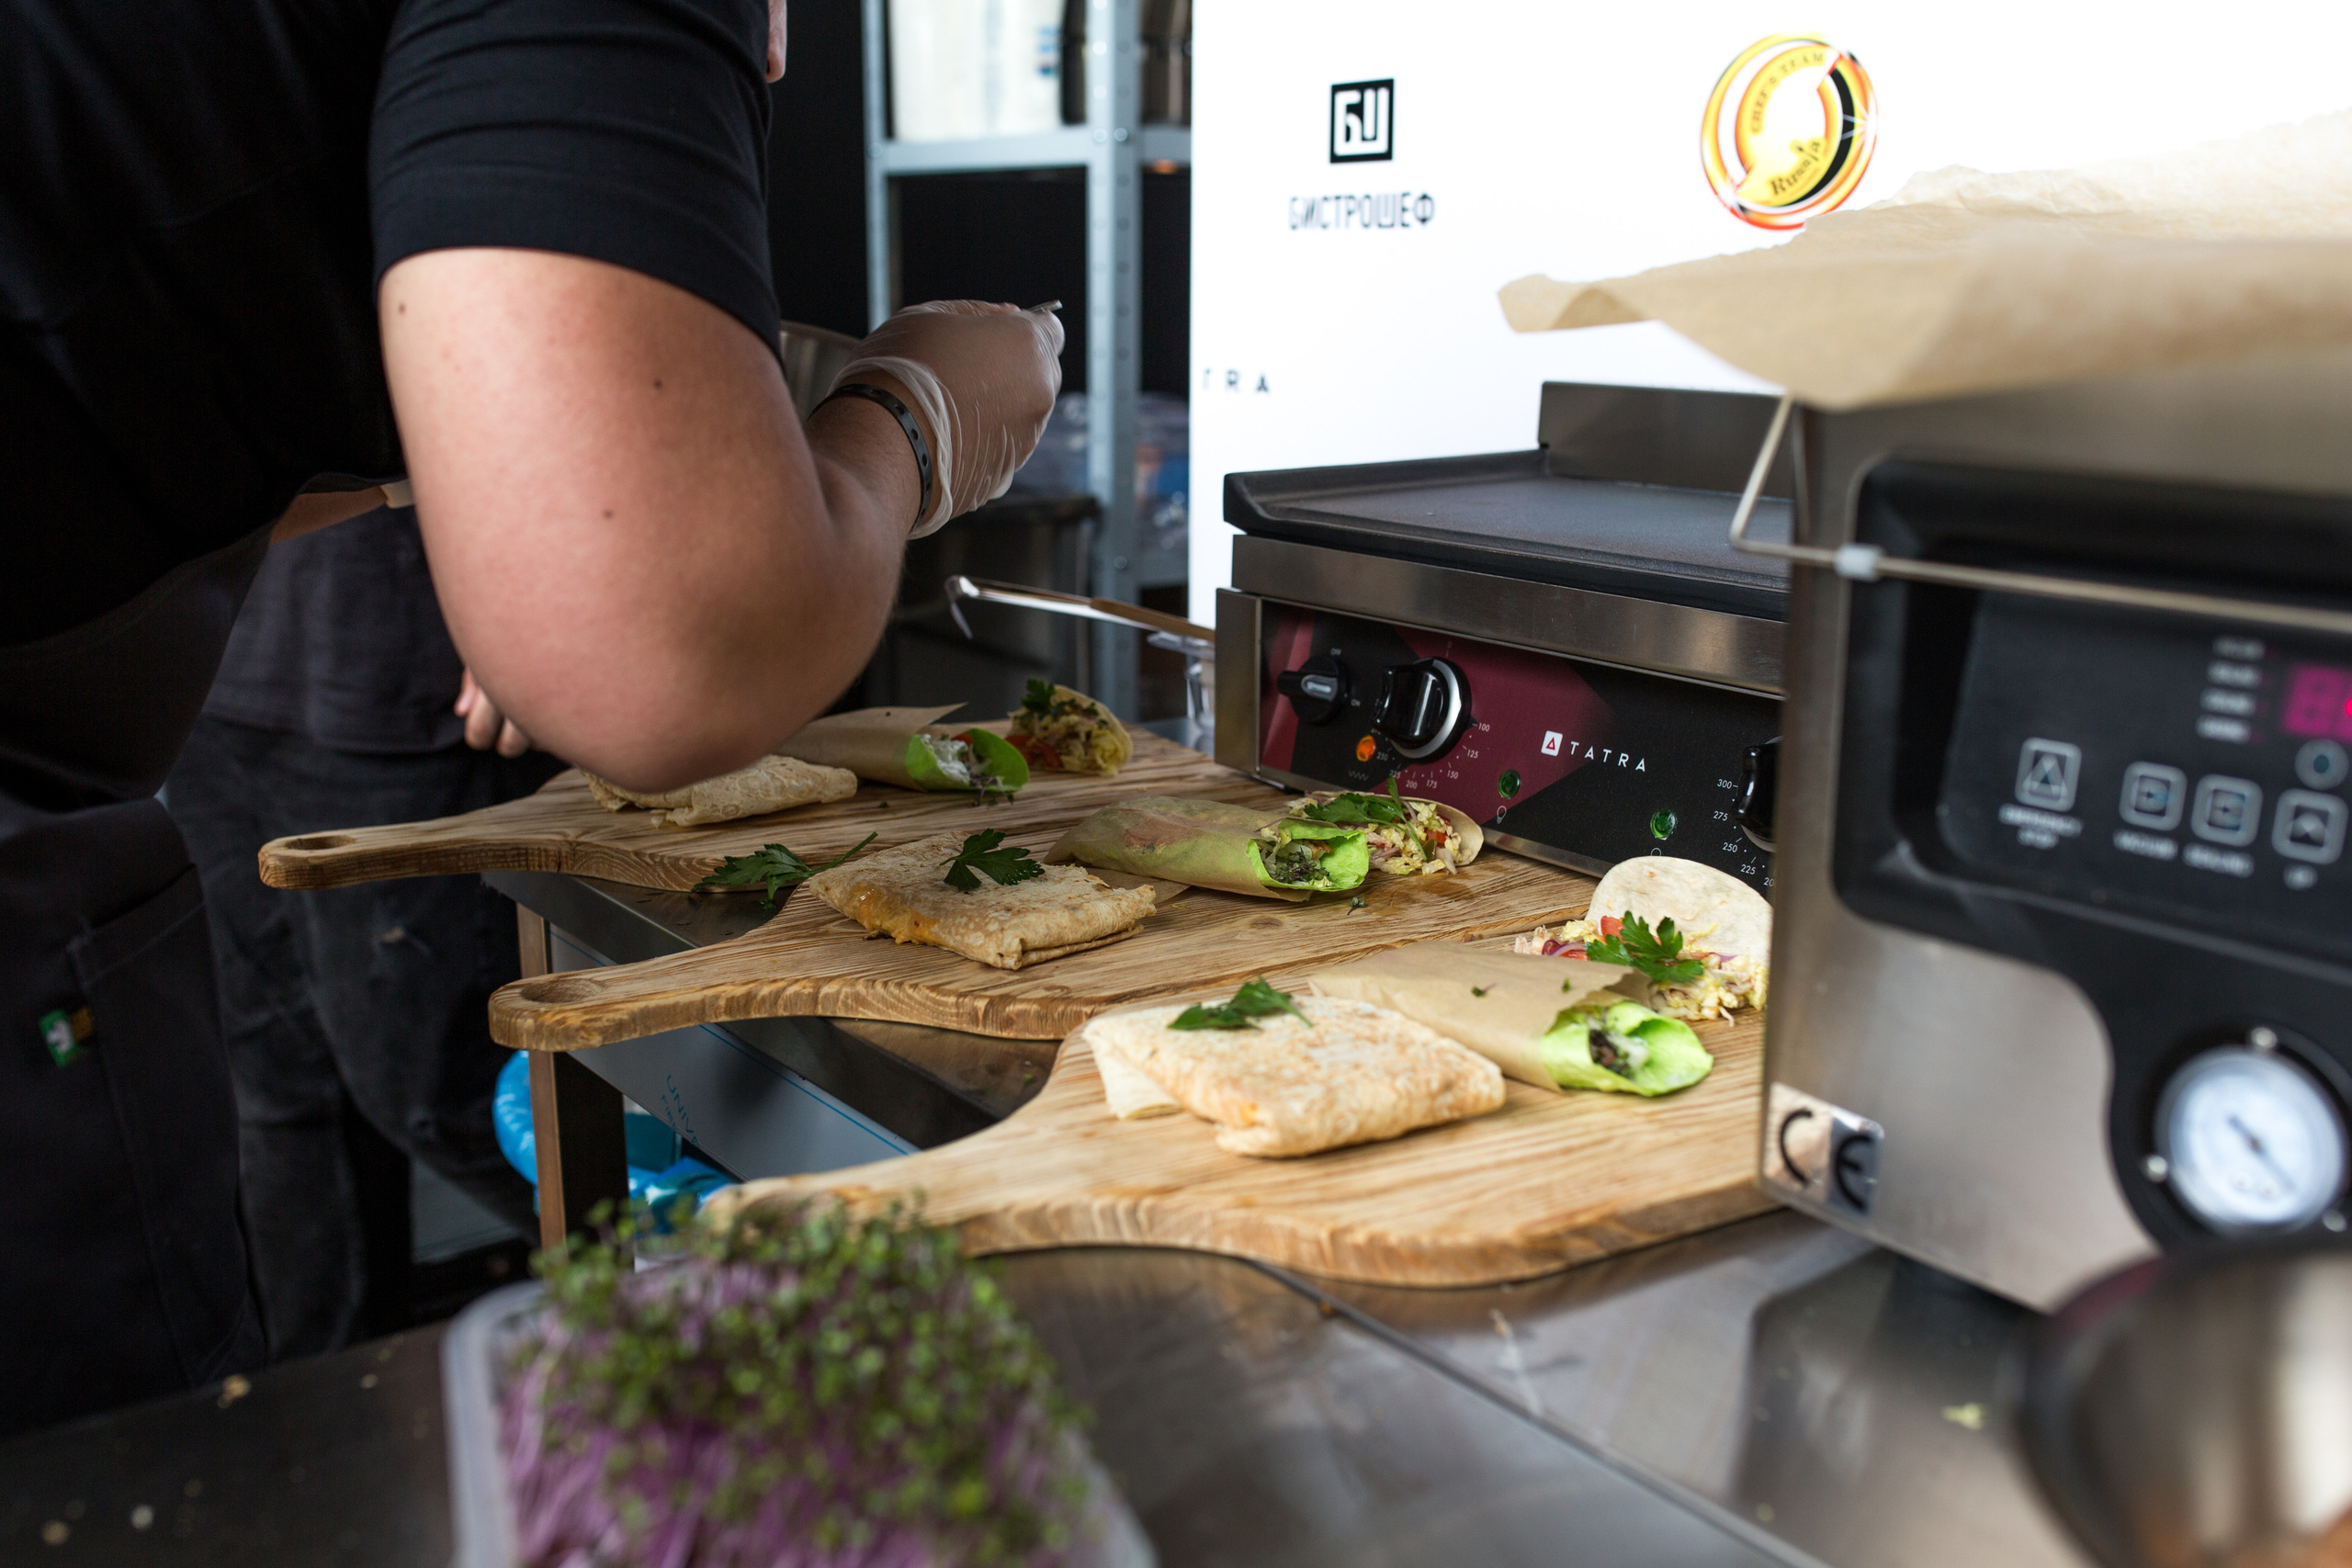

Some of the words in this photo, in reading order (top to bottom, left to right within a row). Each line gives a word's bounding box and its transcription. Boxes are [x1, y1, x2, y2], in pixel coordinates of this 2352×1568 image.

[1290, 191, 1435, 231] БИСТРОШЕФ
[1478, 722, 1490, 732] 100
[1467, 749, 1478, 759] 125
[1570, 740, 1645, 772] TATRA
[1446, 769, 1459, 779] 150
[1406, 779, 1418, 790] 200
[1426, 778, 1438, 789] 175
[1716, 778, 1733, 790] 300
[1713, 810, 1728, 822] 275
[1722, 841, 1738, 853] 250
[1740, 863, 1757, 875] 225
[1763, 876, 1775, 887] 20
[1780, 1108, 1874, 1214] CE
